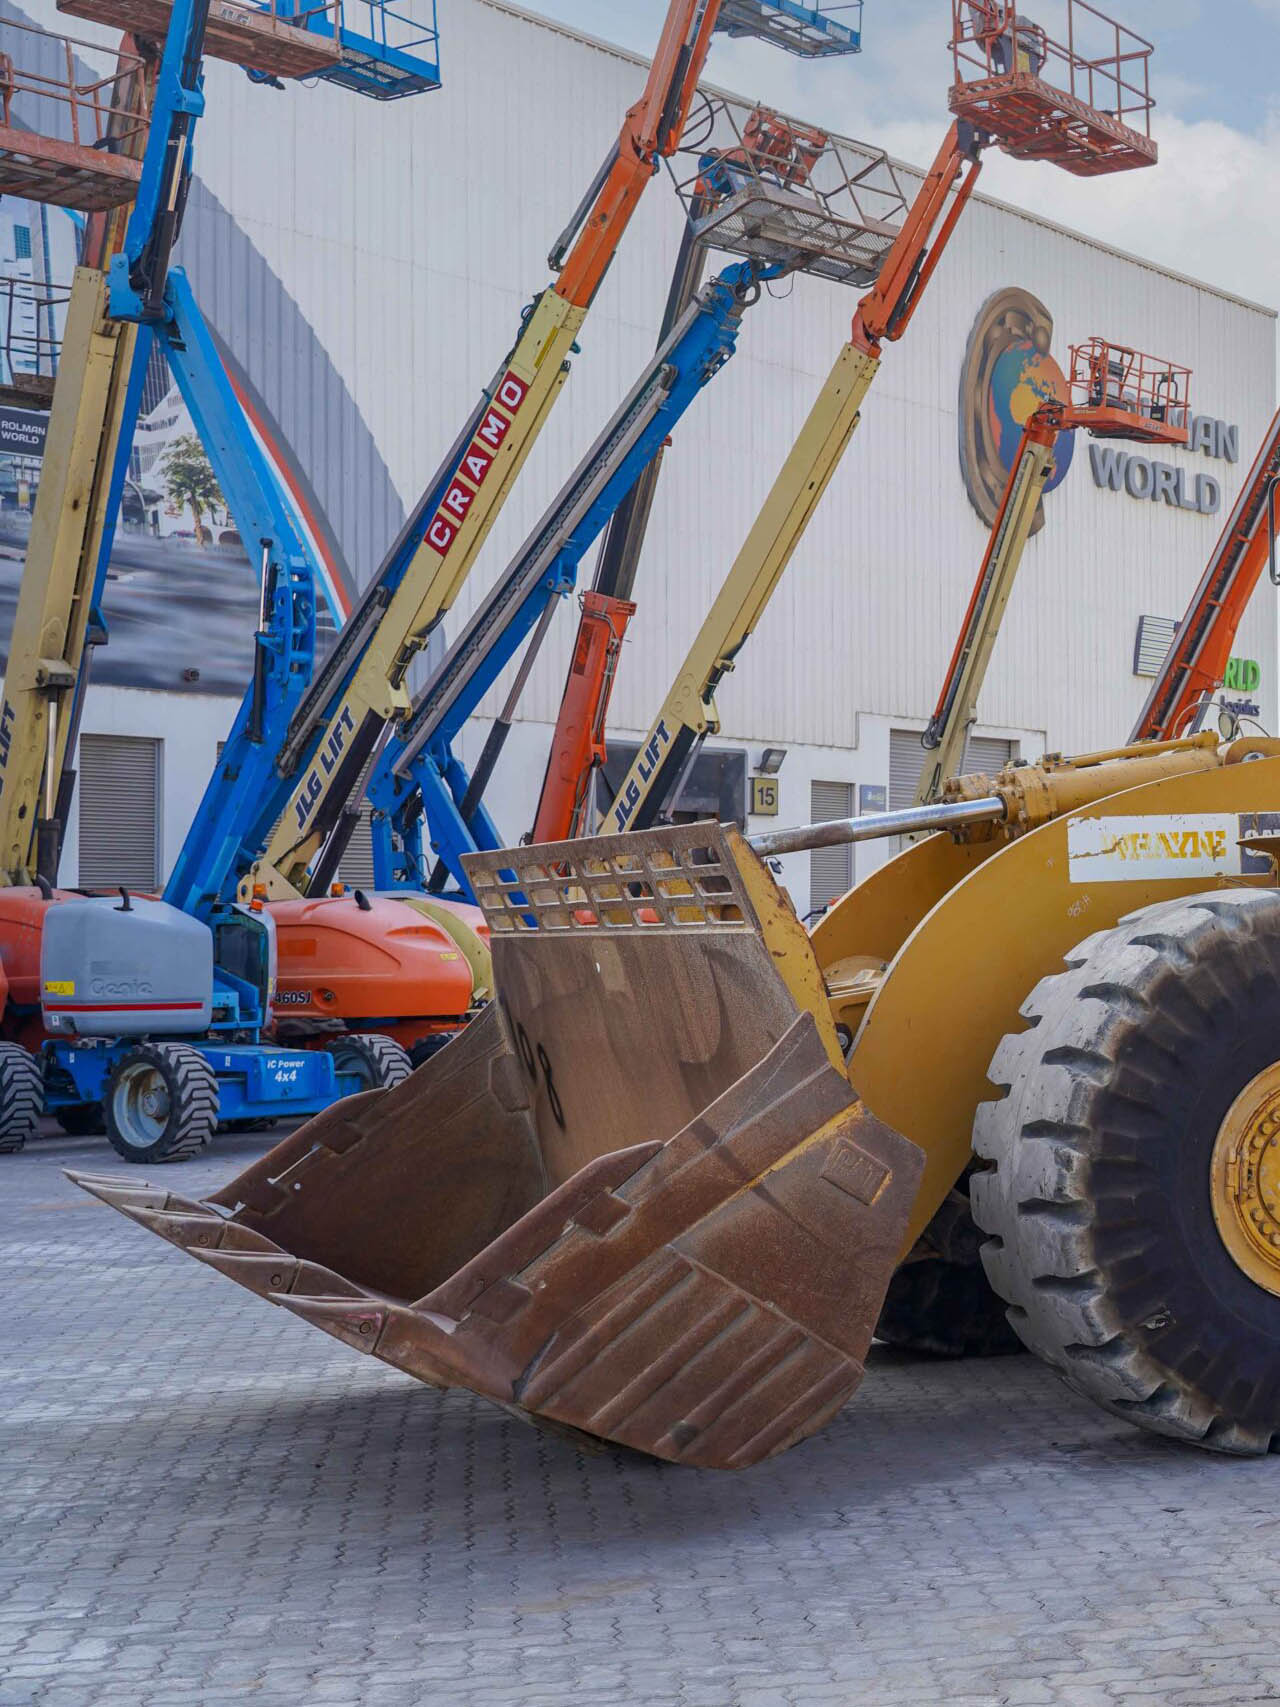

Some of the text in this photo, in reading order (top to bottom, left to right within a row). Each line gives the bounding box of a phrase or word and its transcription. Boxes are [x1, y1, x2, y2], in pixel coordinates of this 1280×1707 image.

[1, 420, 46, 436] ROLMAN
[1, 430, 39, 444] WORLD
[429, 380, 522, 547] CRAMO
[1088, 443, 1221, 515] WORLD
[295, 703, 355, 831] JLG LIFT
[614, 719, 670, 833] JLG LIFT
[758, 786, 775, 806] 15
[278, 1060, 305, 1069] Power
[274, 1070, 297, 1082] 4x4
